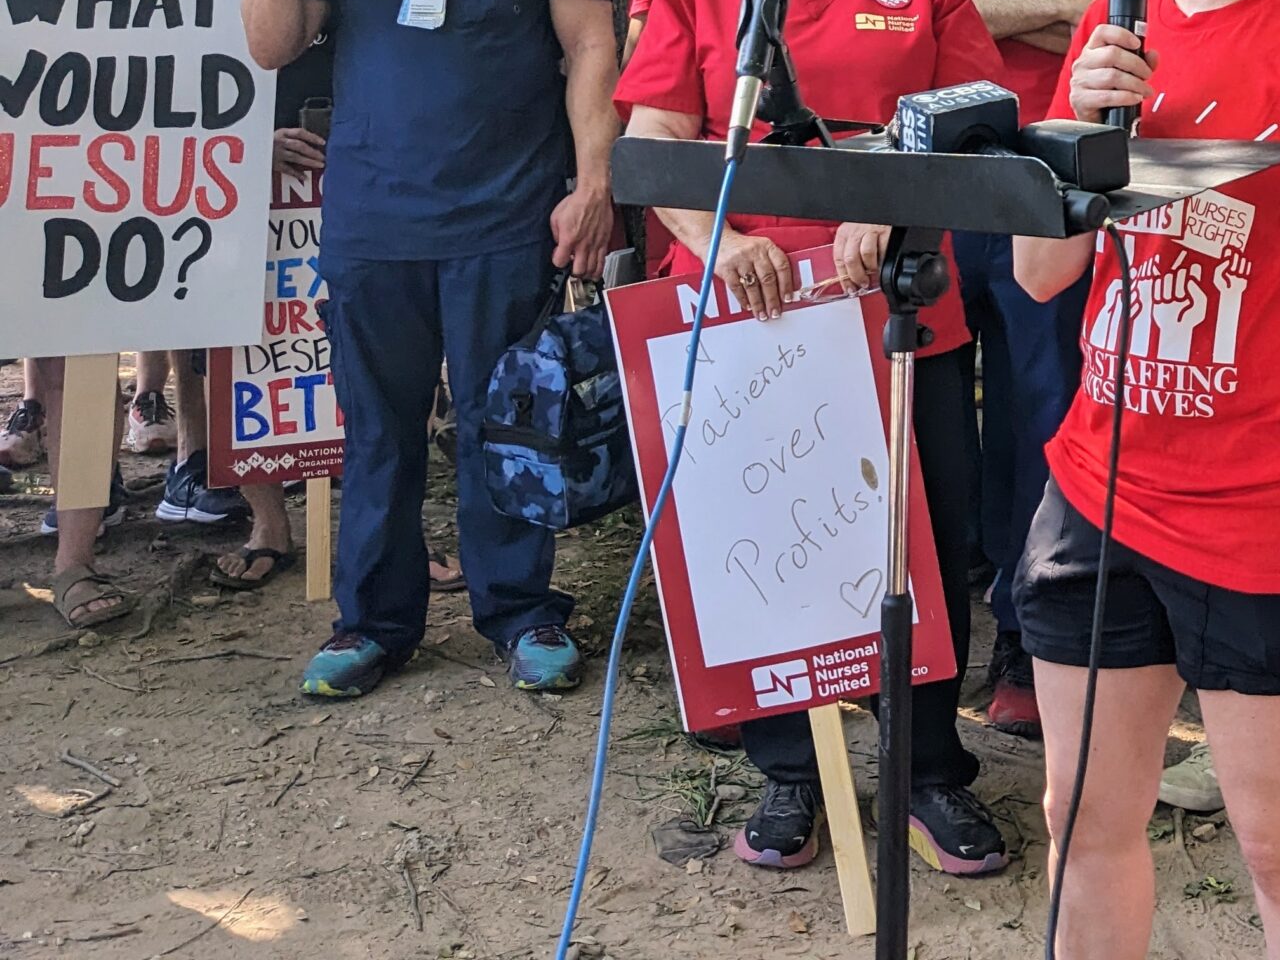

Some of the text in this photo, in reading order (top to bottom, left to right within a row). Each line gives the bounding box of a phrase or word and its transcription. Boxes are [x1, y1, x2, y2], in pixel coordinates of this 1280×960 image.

[928, 87, 1008, 110] AUSTIN
[936, 83, 994, 99] CBS
[1188, 196, 1248, 230] NURSES
[1187, 215, 1246, 250] RIGHTS
[42, 216, 213, 303] DO?
[662, 343, 807, 465] Patients
[1123, 384, 1215, 419] LIVES
[743, 403, 829, 495] over
[813, 641, 879, 668] National
[815, 660, 870, 683] Nurses
[817, 674, 871, 699] United
